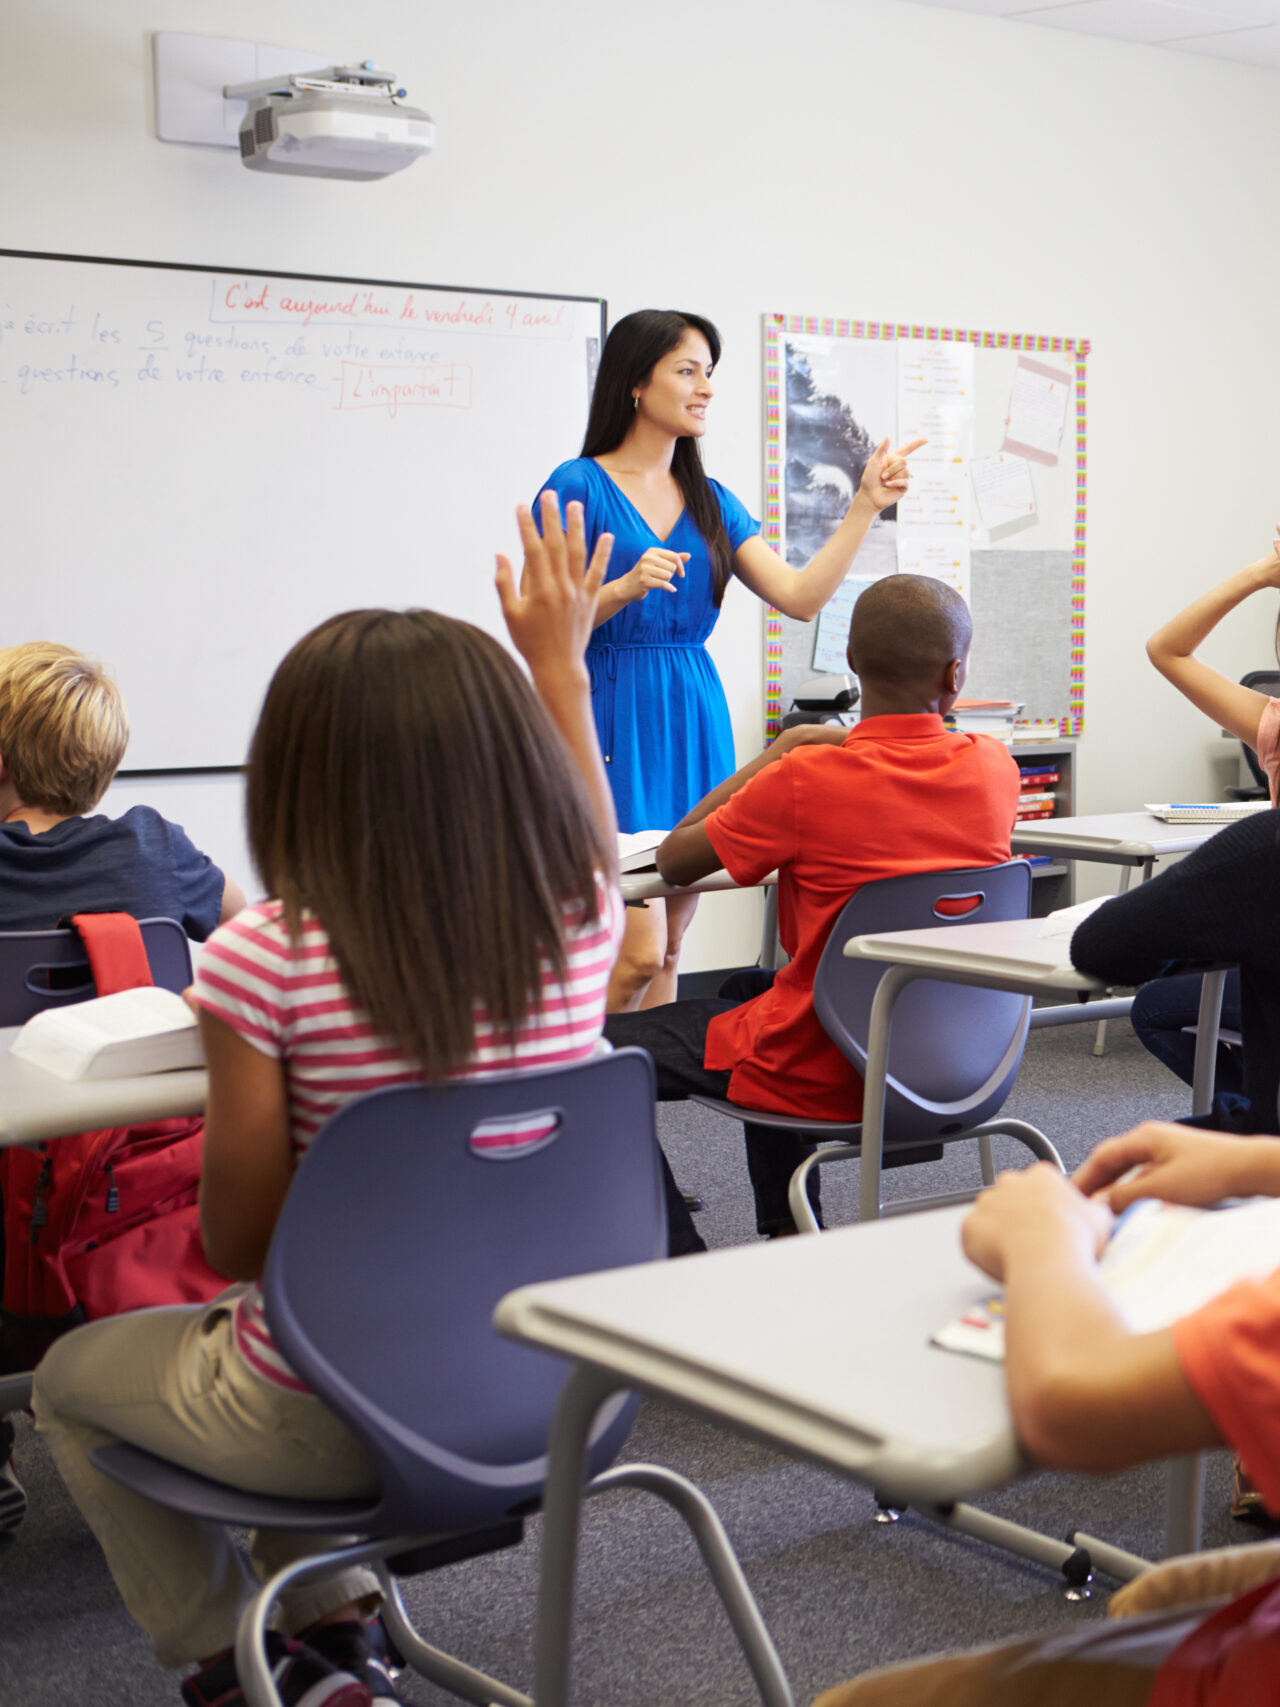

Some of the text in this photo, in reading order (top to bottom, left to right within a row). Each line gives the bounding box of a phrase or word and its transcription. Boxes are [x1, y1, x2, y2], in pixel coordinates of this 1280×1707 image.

[399, 294, 419, 320] le
[505, 303, 518, 330] 4
[91, 311, 121, 345] les
[184, 325, 270, 358] questions
[284, 336, 310, 356] de
[322, 328, 369, 359] votre
[17, 352, 121, 395] questions
[136, 352, 162, 382] de
[176, 354, 226, 383] votre
